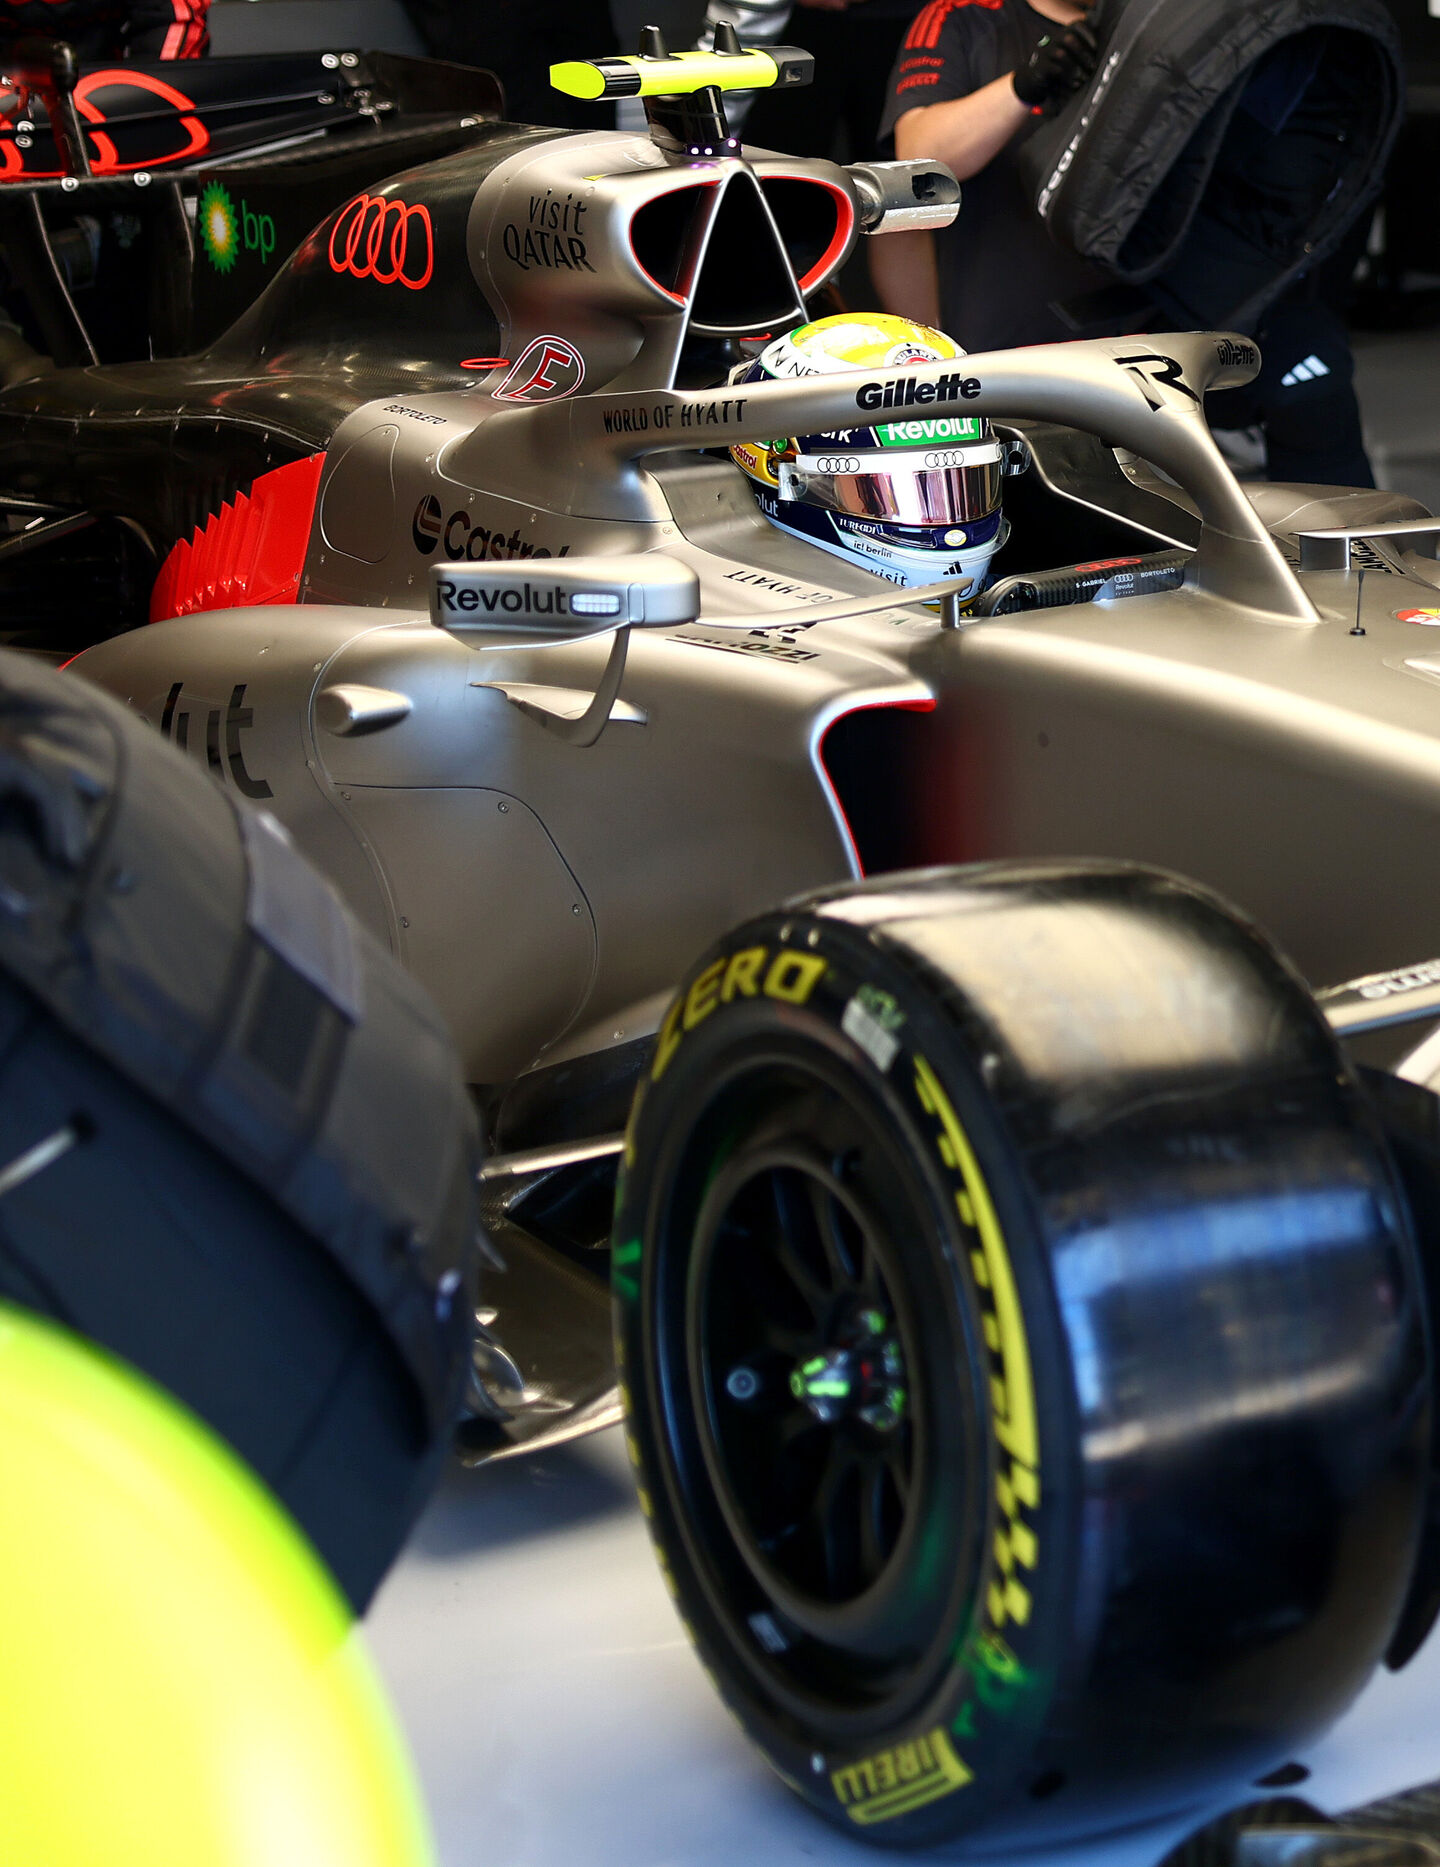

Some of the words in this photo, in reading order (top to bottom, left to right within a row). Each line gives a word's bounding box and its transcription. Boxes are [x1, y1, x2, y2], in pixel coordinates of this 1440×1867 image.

[242, 200, 276, 264] bp
[528, 189, 587, 236] visit
[503, 223, 598, 273] QATAR
[855, 372, 982, 411] Gillette
[602, 407, 648, 434] WORLD
[653, 404, 675, 429] OF
[681, 399, 748, 427] HYATT
[735, 445, 758, 469] astrol
[436, 580, 568, 615] Revolut
